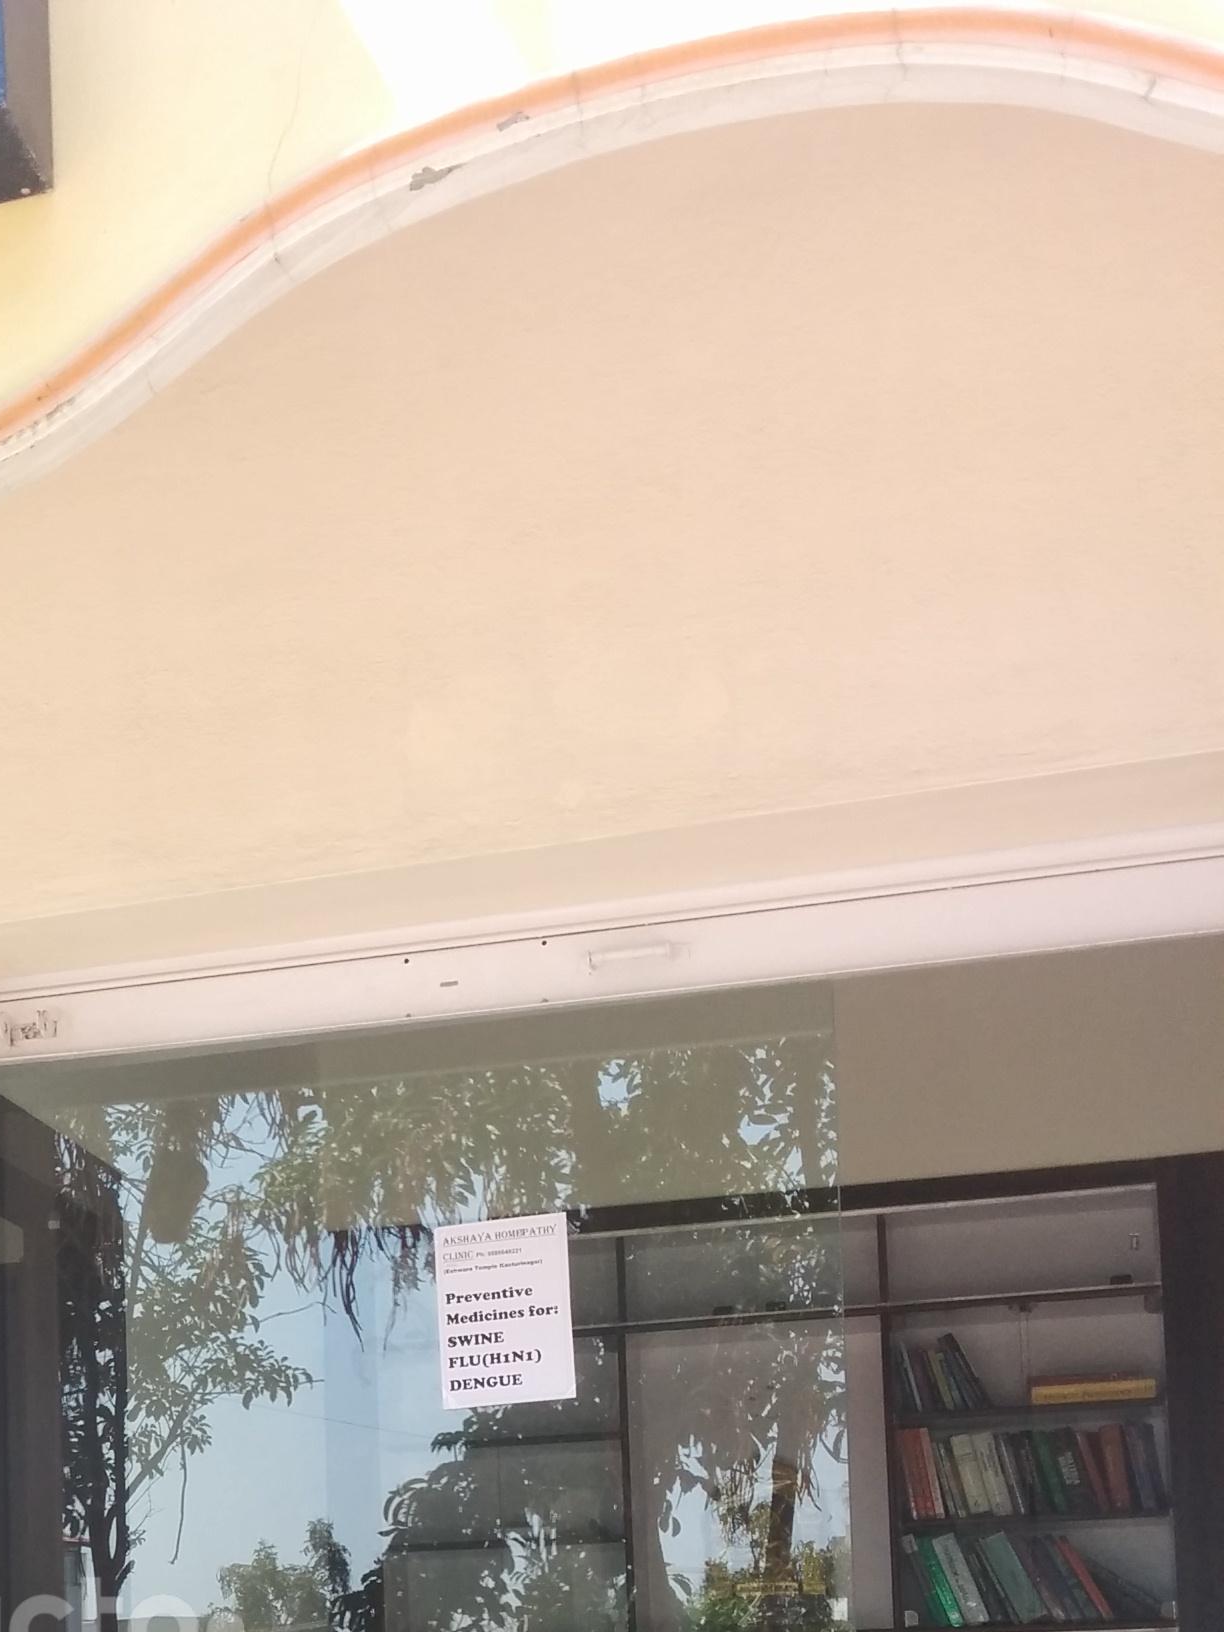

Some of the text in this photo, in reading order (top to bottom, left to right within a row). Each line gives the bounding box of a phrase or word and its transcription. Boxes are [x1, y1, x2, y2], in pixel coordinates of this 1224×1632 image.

[443, 1232, 492, 1246] AKSHAYA
[443, 1250, 473, 1261] CLINIC
[445, 1286, 533, 1304] Preventive
[446, 1305, 559, 1325] Medicines for:
[447, 1331, 505, 1348] SWINE
[448, 1349, 542, 1369] FLU(H1N1)
[450, 1374, 523, 1391] DENGUE
